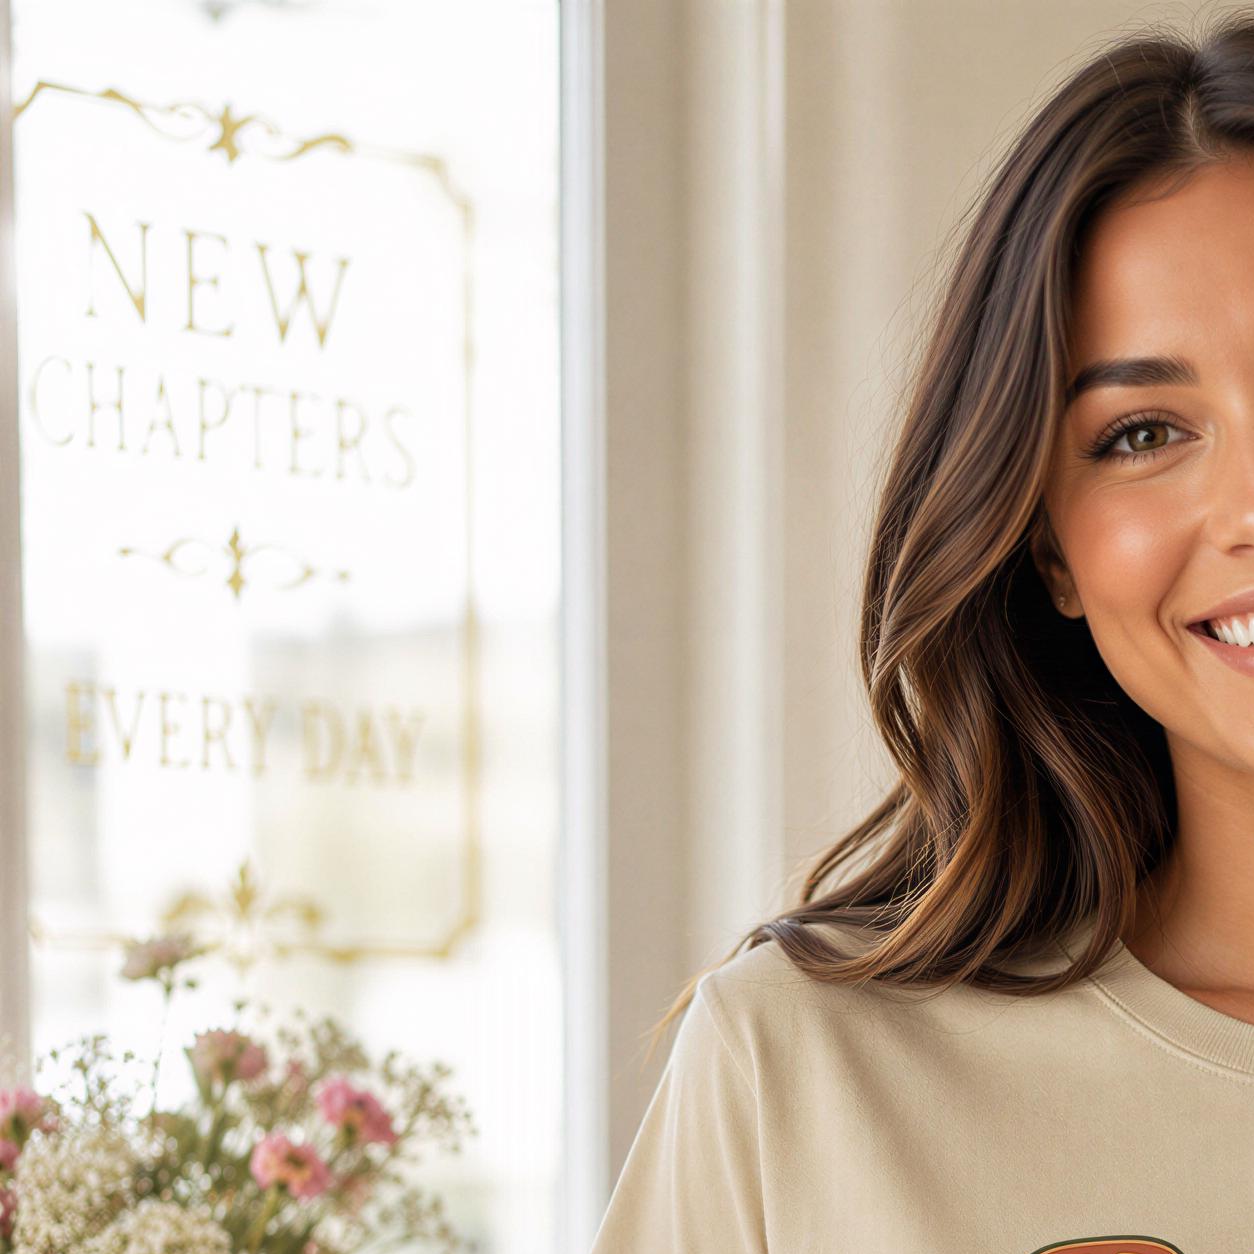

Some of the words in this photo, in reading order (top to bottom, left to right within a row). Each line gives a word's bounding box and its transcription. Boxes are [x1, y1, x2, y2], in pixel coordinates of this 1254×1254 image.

[84, 210, 349, 349] NEW
[30, 355, 416, 489] CHAPTERS
[65, 681, 277, 777] EVERY
[302, 696, 426, 787] DAY
